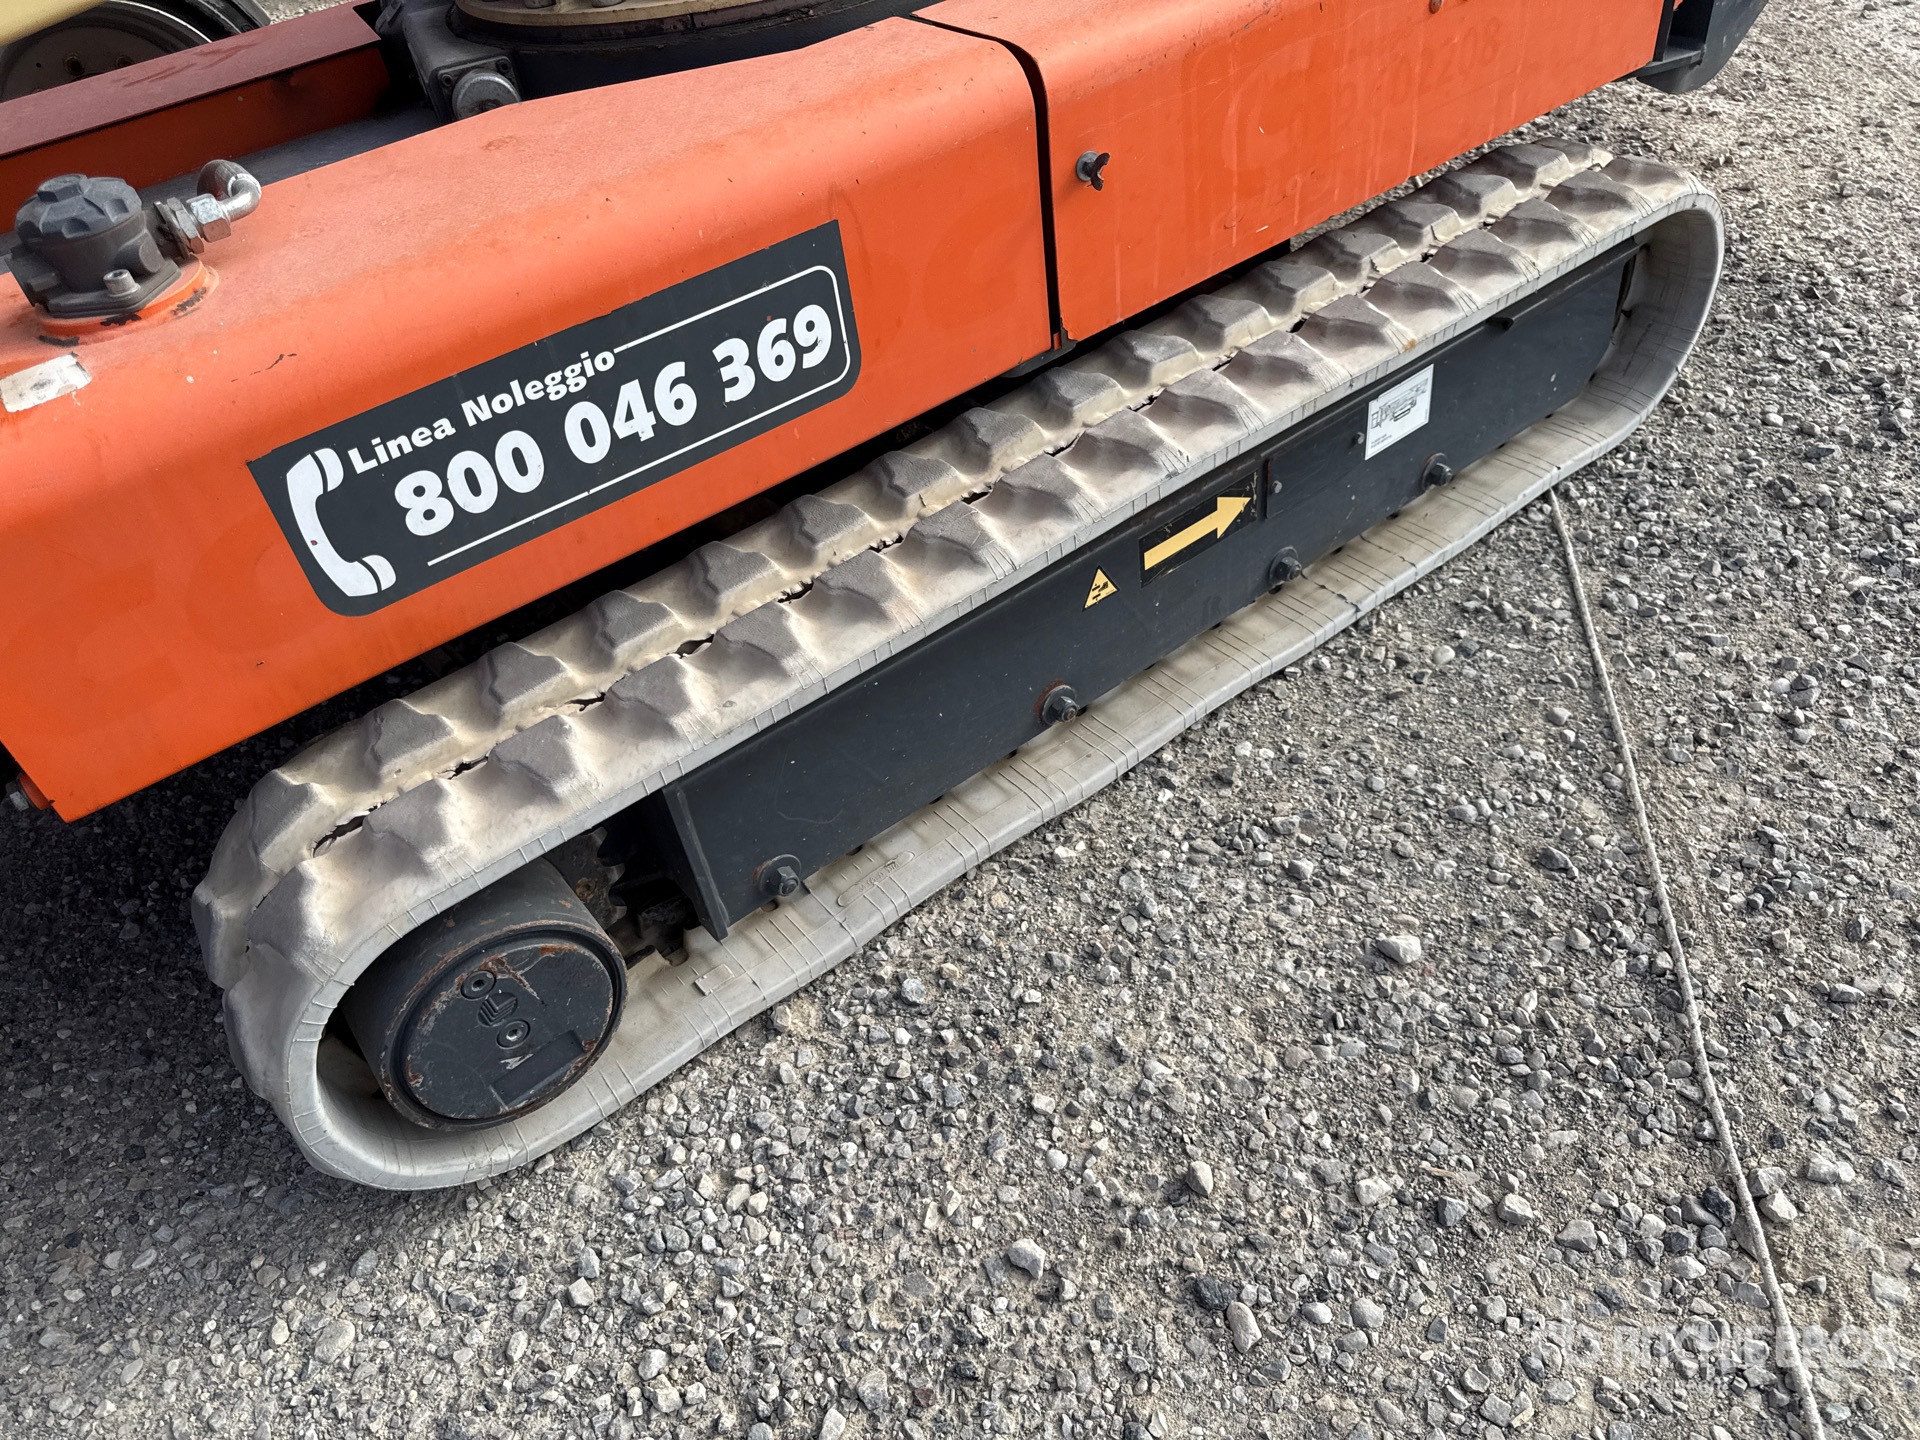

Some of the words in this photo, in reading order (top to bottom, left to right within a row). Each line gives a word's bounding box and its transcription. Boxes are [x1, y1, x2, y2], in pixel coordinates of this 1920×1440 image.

[347, 416, 457, 475] Linea
[460, 347, 616, 427] Noleggio
[394, 429, 545, 537] 800
[564, 361, 698, 464] 046
[711, 304, 832, 403] 369
